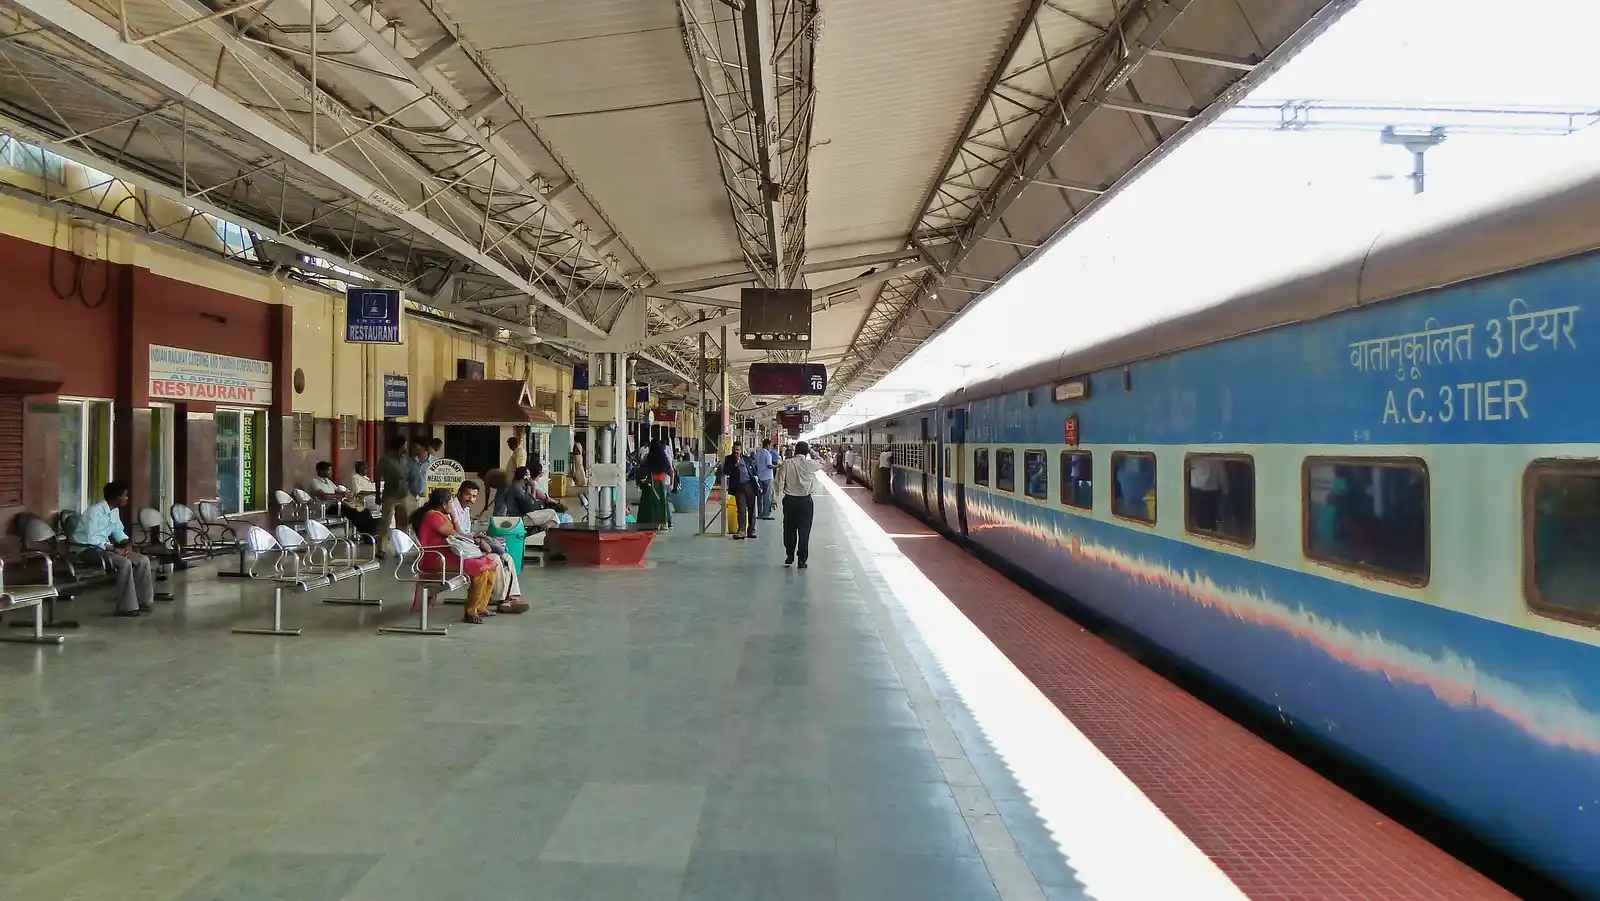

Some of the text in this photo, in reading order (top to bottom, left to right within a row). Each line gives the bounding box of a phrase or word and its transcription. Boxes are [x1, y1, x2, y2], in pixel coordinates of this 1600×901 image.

[349, 325, 398, 341] RESTAURANT
[152, 380, 256, 400] RESTAURANT
[811, 380, 823, 390] 16
[1456, 378, 1529, 421] TIER
[244, 416, 252, 504] RESTAURANT
[430, 459, 462, 473] RESTAURANT
